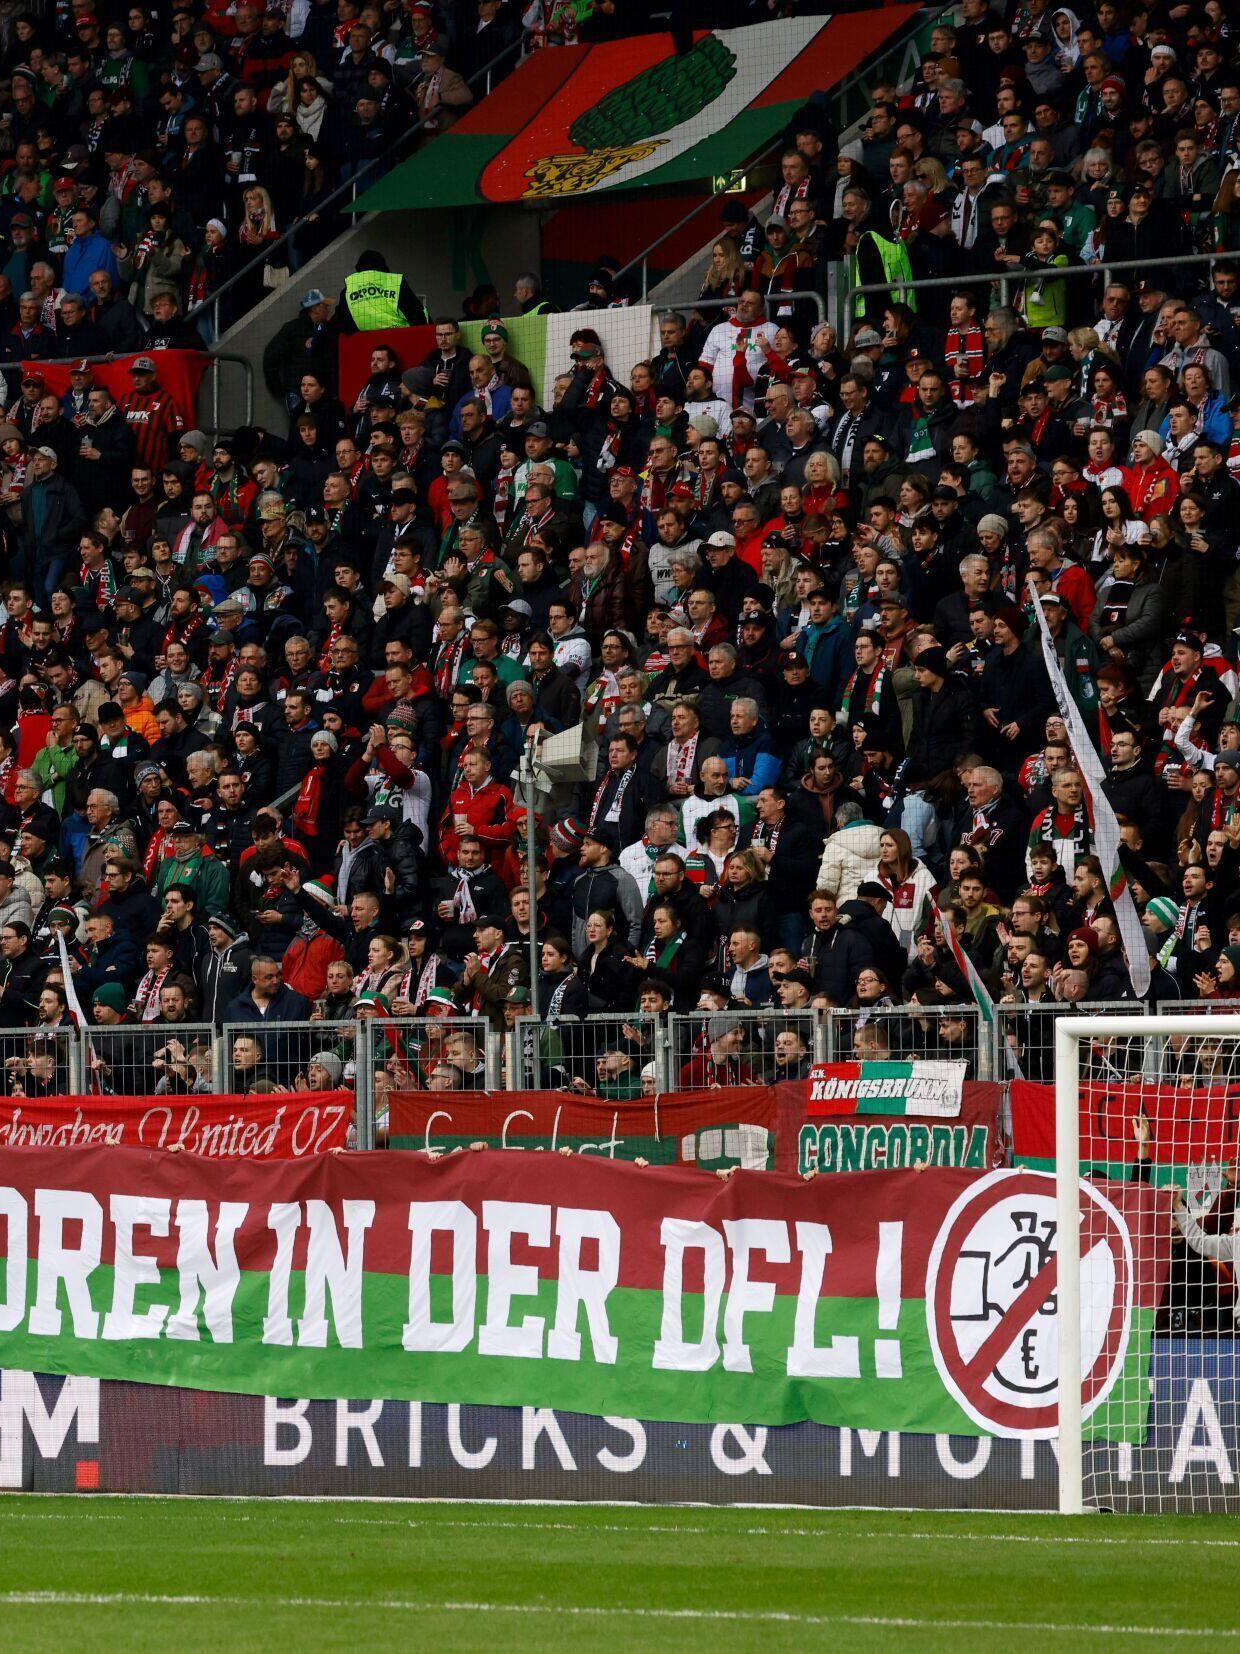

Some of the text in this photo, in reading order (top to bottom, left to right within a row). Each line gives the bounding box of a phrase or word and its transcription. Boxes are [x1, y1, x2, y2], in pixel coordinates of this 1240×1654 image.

[126, 409, 151, 422] WWK
[810, 1076, 948, 1101] KÖNIGSBRUNN
[138, 1105, 287, 1157] United
[292, 1105, 346, 1156] 07
[798, 1124, 988, 1175] CONCORDIA
[261, 1199, 375, 1348] IN
[402, 1201, 620, 1364] DER
[263, 1395, 648, 1472] BRICKS
